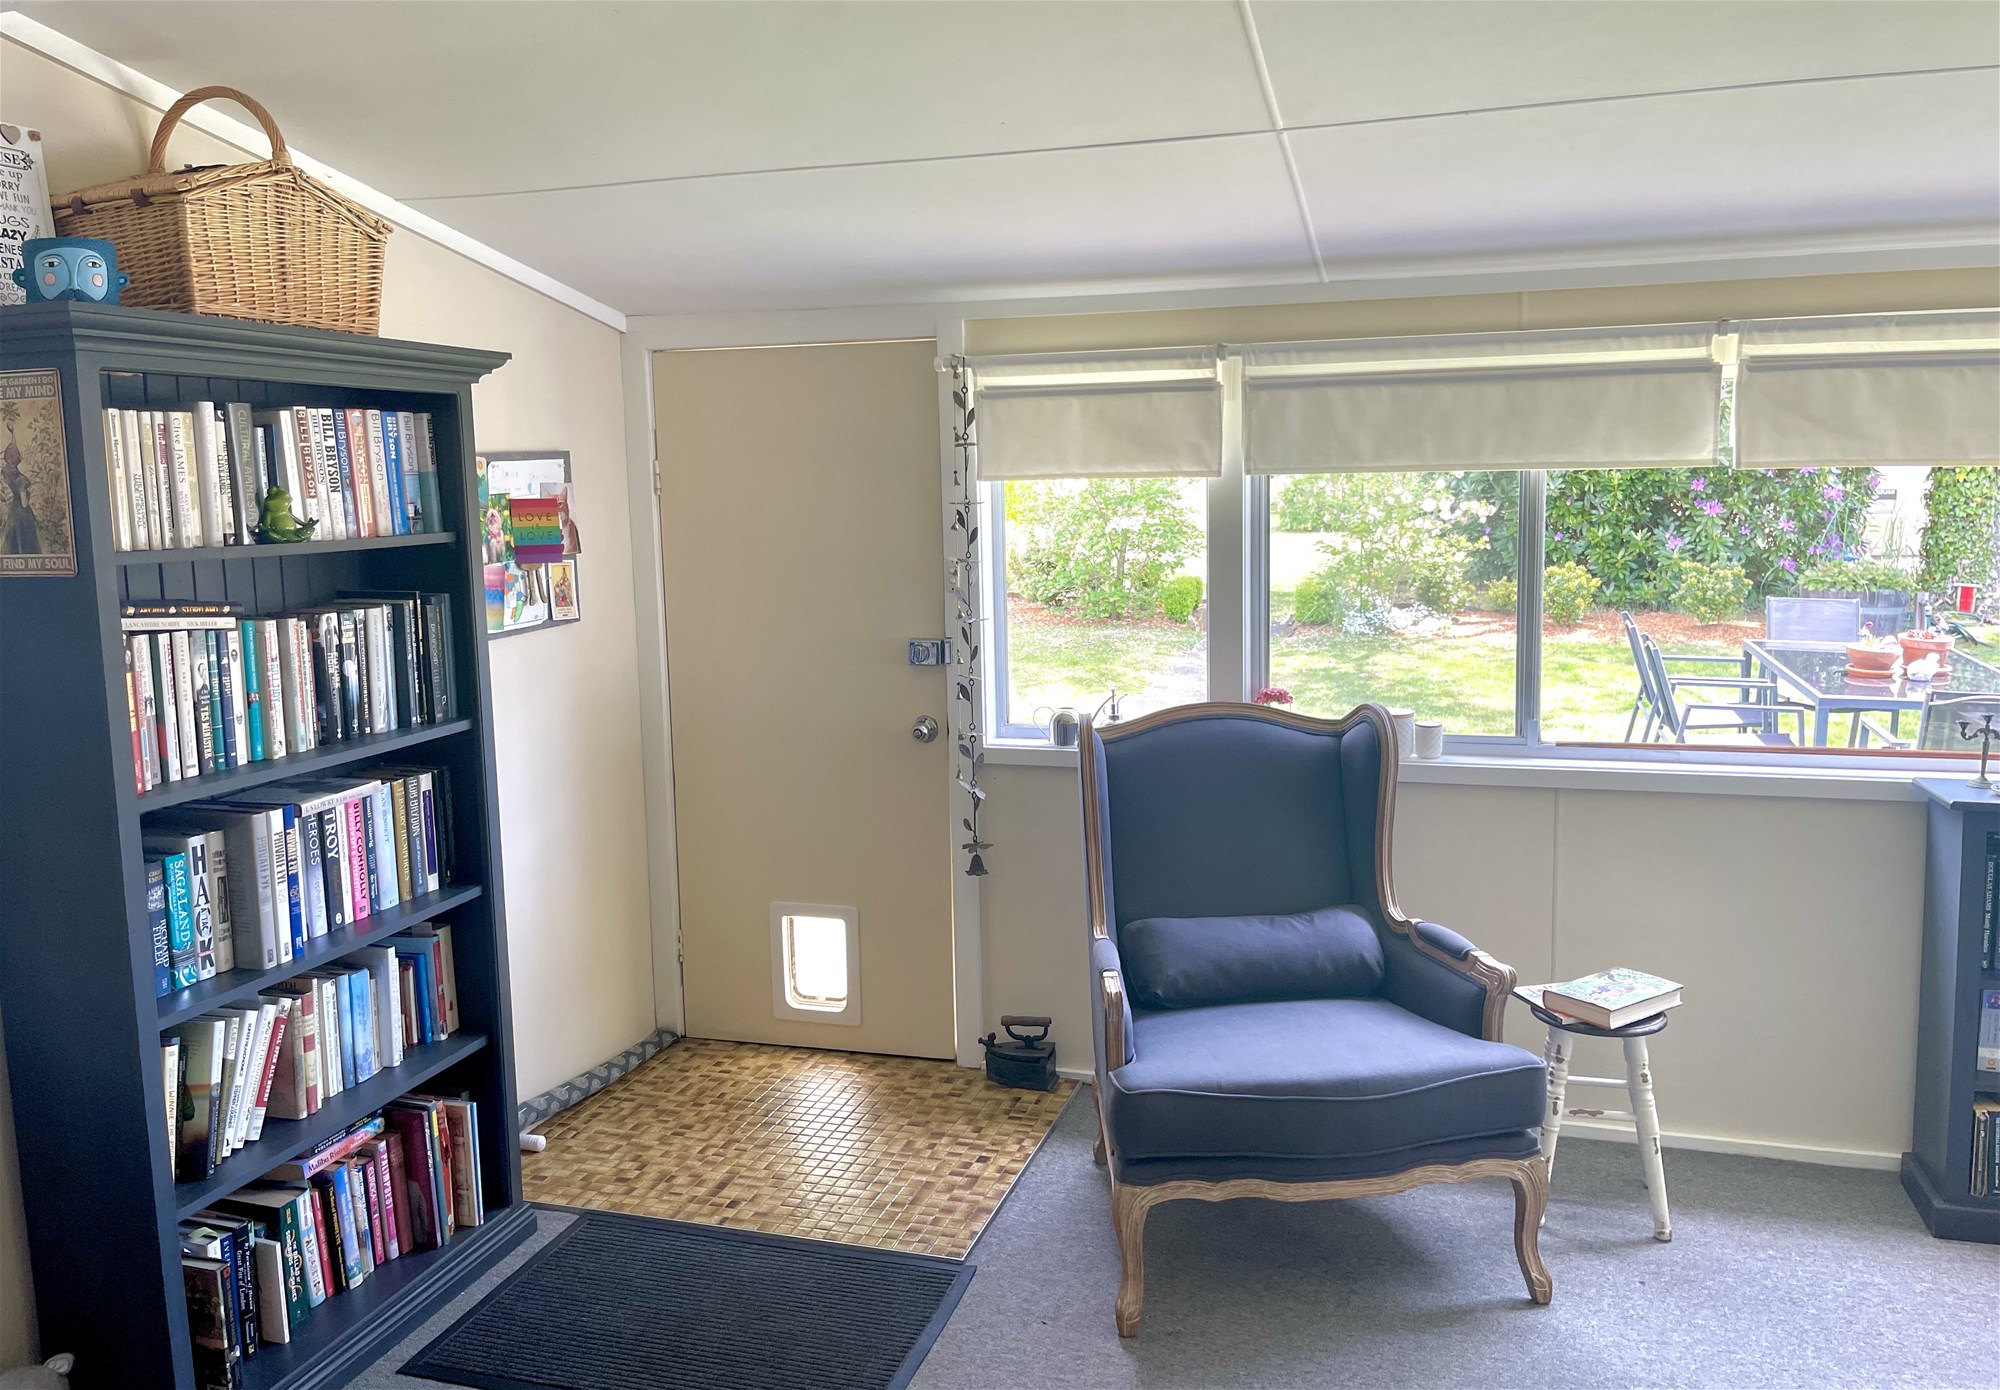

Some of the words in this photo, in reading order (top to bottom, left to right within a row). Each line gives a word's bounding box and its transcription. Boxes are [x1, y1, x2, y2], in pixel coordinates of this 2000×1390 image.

[13, 193, 30, 204] FUN
[6, 387, 21, 398] MY
[25, 384, 54, 397] MIND
[9, 376, 36, 385] GARDEN
[172, 417, 182, 445] Clive
[321, 413, 334, 441] BILL
[336, 412, 345, 430] Bill
[371, 413, 380, 433] Bill
[237, 410, 251, 464] CULTURAL
[338, 431, 350, 473] Bryson
[386, 416, 396, 459] BRYSON
[405, 433, 415, 471] Bryson
[175, 447, 186, 483] JAMES
[298, 411, 308, 440] BILL
[303, 447, 316, 496] BRYSON
[315, 441, 325, 483] BRYSON
[373, 436, 385, 481] Bryson
[325, 445, 340, 494] BRYSON
[243, 466, 257, 520] AMNESIA
[518, 512, 552, 522] LOVE
[520, 530, 553, 541] LOVE
[3, 558, 25, 569] FIND
[28, 558, 42, 568] MY
[45, 558, 70, 568] SOUL
[332, 652, 341, 688] FUTURE
[200, 706, 210, 722] YES
[202, 722, 213, 759] MINISTER
[408, 779, 418, 798] ROB
[381, 810, 390, 843] BENNETT
[398, 798, 406, 826] BARRY
[410, 800, 422, 836] BRYDON
[307, 814, 320, 866] HEROES
[323, 810, 340, 859] TROY
[257, 836, 268, 873] PRIVATE
[273, 832, 286, 869] PRIVATE
[400, 830, 410, 881] HUMPHRIES
[260, 876, 270, 891] EYE
[276, 870, 287, 886] EYE
[356, 837, 367, 900] CONNOLLY
[314, 874, 323, 904] Stephen
[153, 926, 162, 966] FIDLER
[159, 919, 169, 968] RICHARD
[276, 1024, 285, 1044] STILL
[272, 1046, 280, 1063] OPEN
[262, 1080, 272, 1102] HOURS
[308, 1155, 330, 1173] Malibu
[328, 1144, 349, 1161] Rising
[314, 1140, 333, 1154] EVELYN
[292, 1251, 301, 1275] BALLAD
